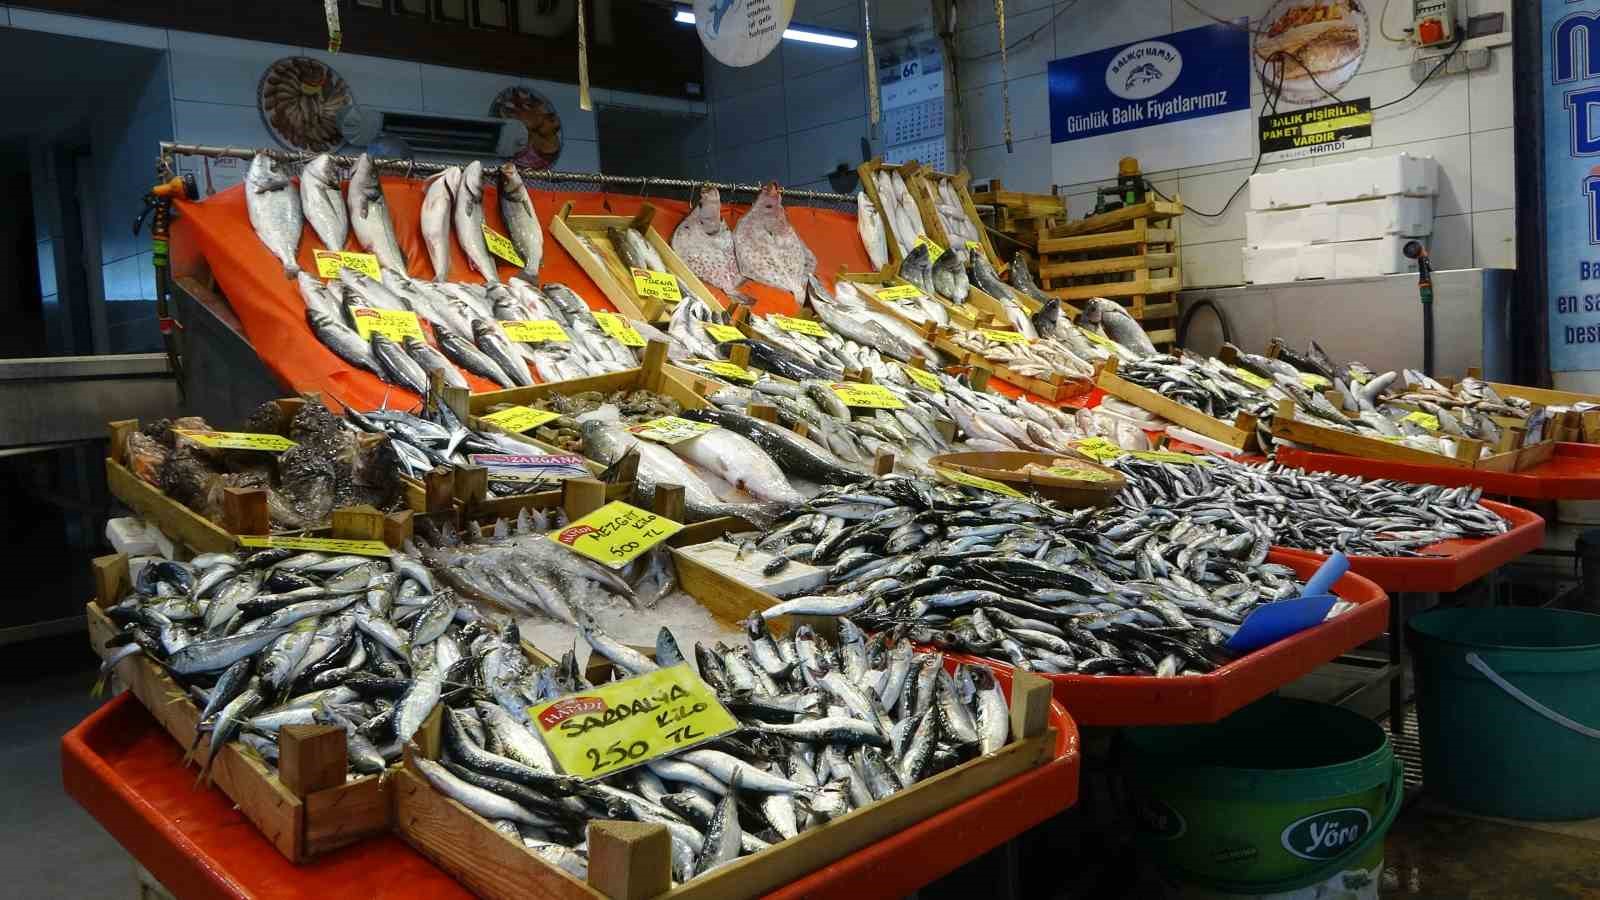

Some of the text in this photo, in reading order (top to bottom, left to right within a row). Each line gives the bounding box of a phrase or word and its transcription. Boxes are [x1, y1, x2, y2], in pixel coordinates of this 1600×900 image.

[1067, 90, 1228, 133] Günlük Balık Fiyatlarımız
[1270, 114, 1303, 128] BALIK
[1263, 127, 1299, 140] PAKET
[1293, 132, 1336, 146] VARDIR
[1558, 295, 1578, 314] en
[610, 529, 664, 557] 500 TL
[560, 684, 690, 738] SARDALYA
[586, 725, 705, 771] 250 TL
